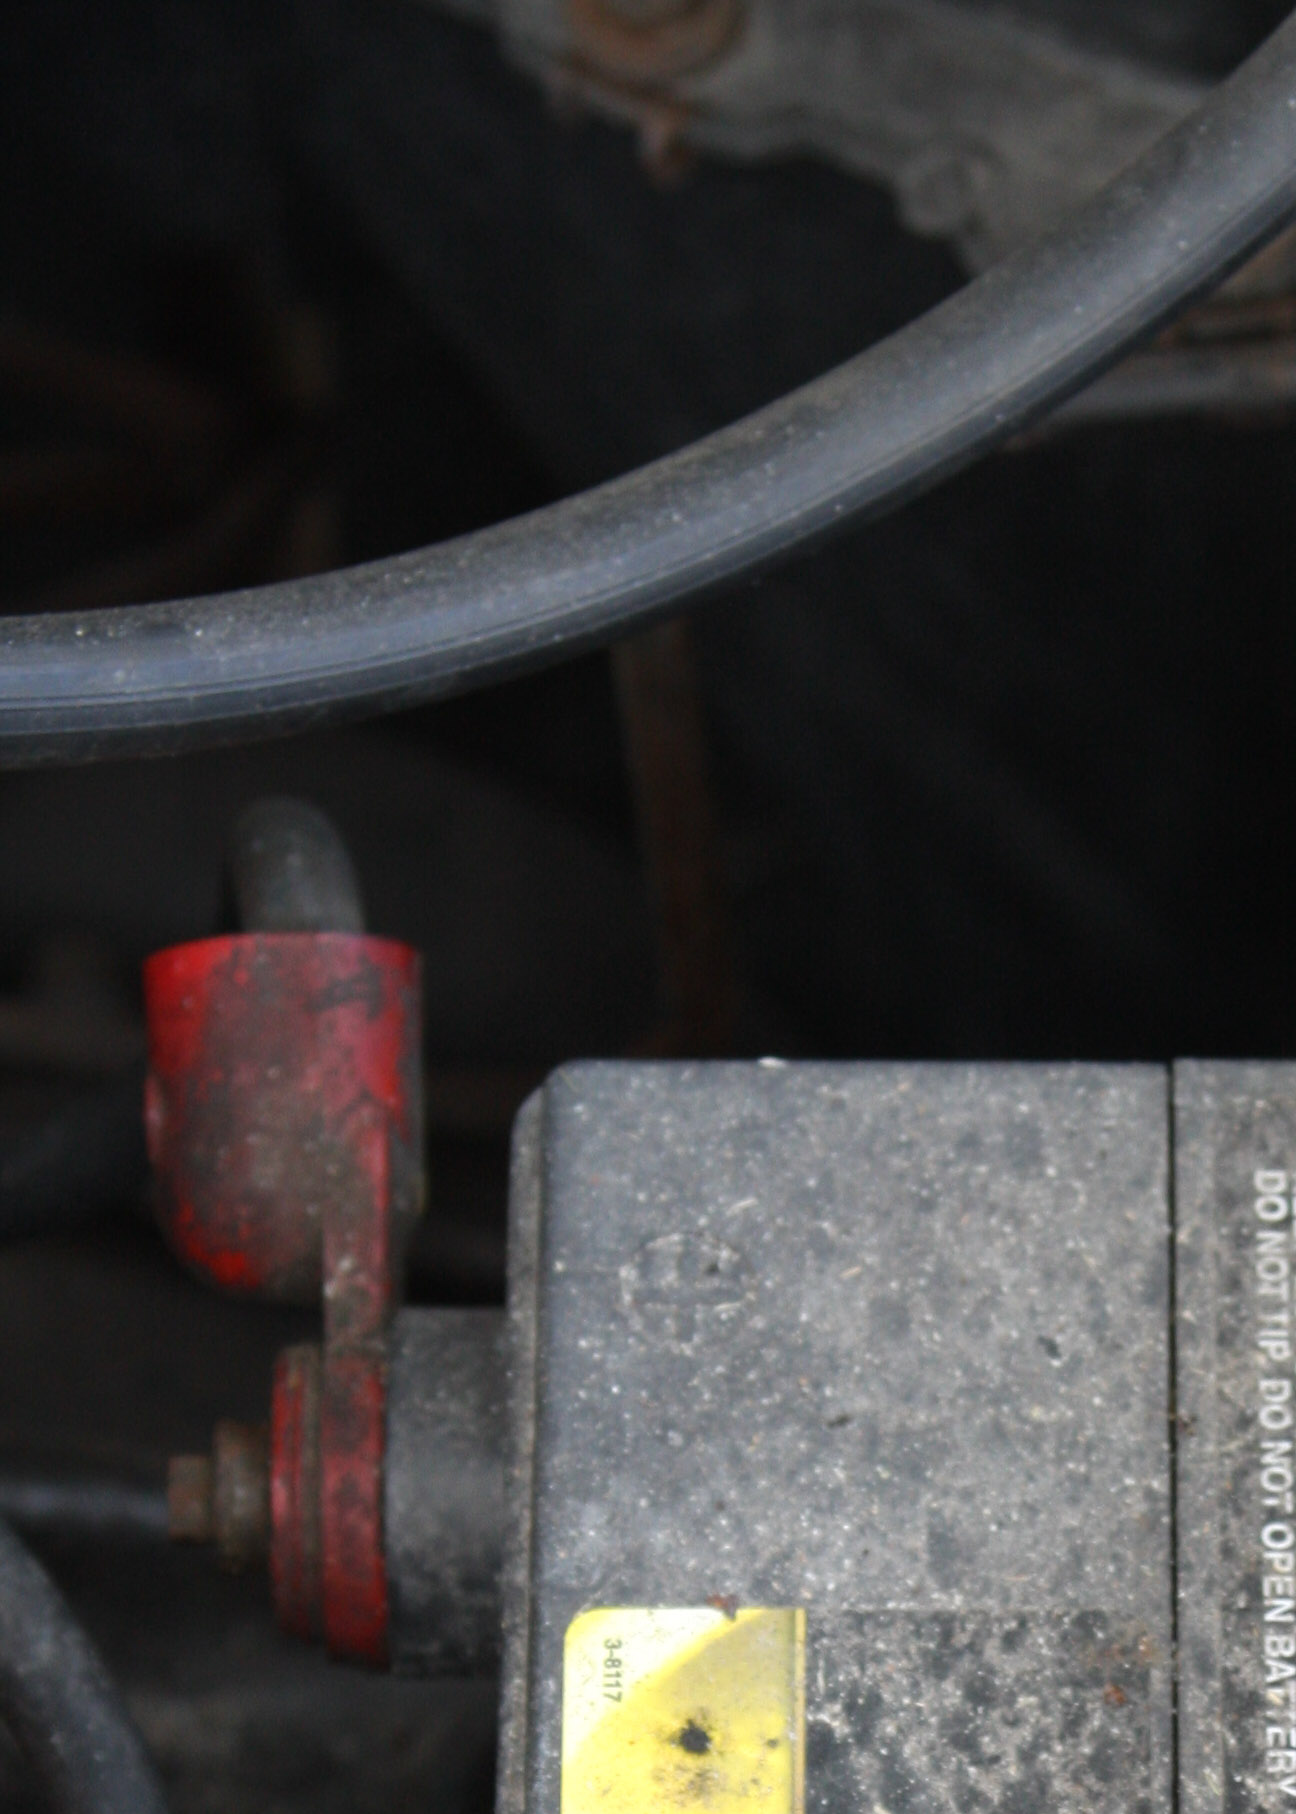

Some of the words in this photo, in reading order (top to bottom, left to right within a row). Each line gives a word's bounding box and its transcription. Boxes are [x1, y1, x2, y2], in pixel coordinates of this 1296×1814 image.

[1253, 1169, 1289, 1222] DO
[1255, 1231, 1290, 1301] NOT
[1259, 1380, 1293, 1430] DO
[1261, 1441, 1295, 1514] NOT
[602, 1638, 624, 1703] 3-8117
